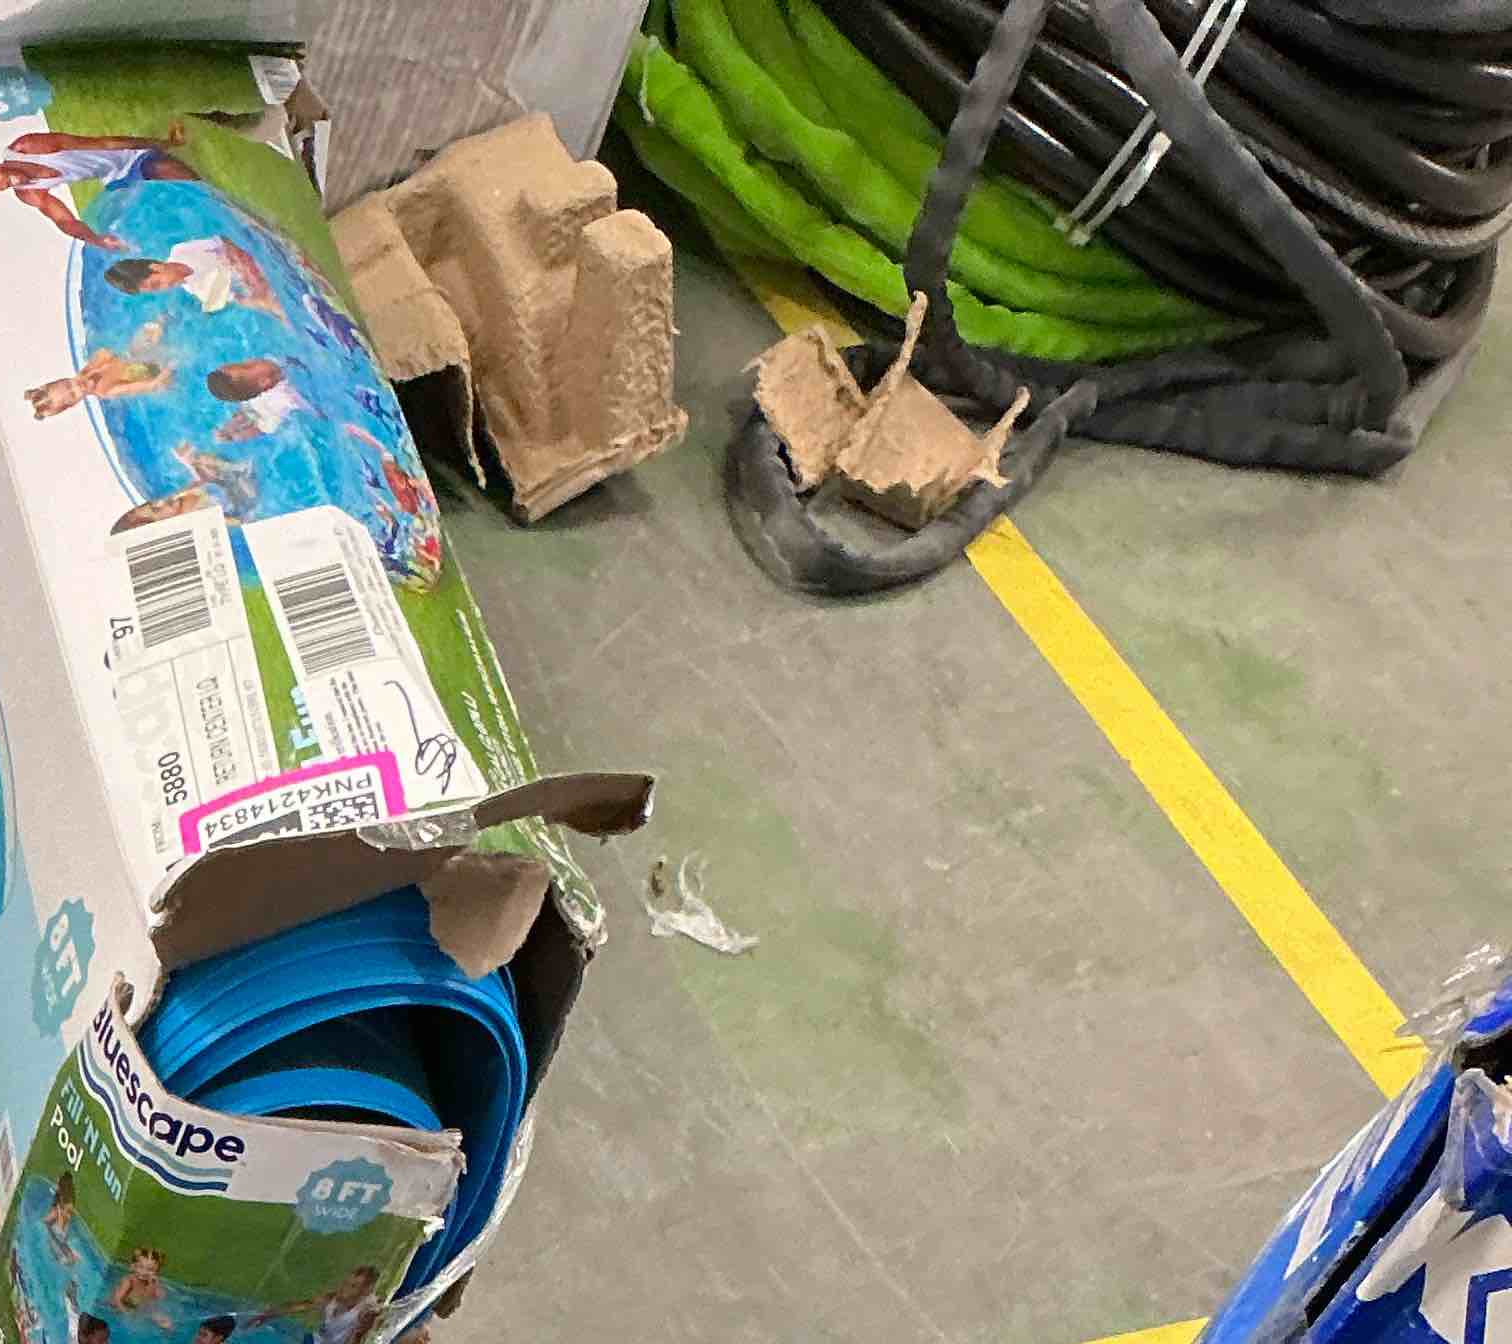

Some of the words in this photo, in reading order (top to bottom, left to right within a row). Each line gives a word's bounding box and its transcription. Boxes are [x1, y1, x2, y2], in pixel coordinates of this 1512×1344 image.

[158, 751, 188, 807] 5880
[204, 772, 373, 838] PNK4214834
[49, 1102, 84, 1173] Pool
[96, 1145, 124, 1202] Fun
[311, 1177, 338, 1200] 8
[338, 1181, 384, 1205] FT
